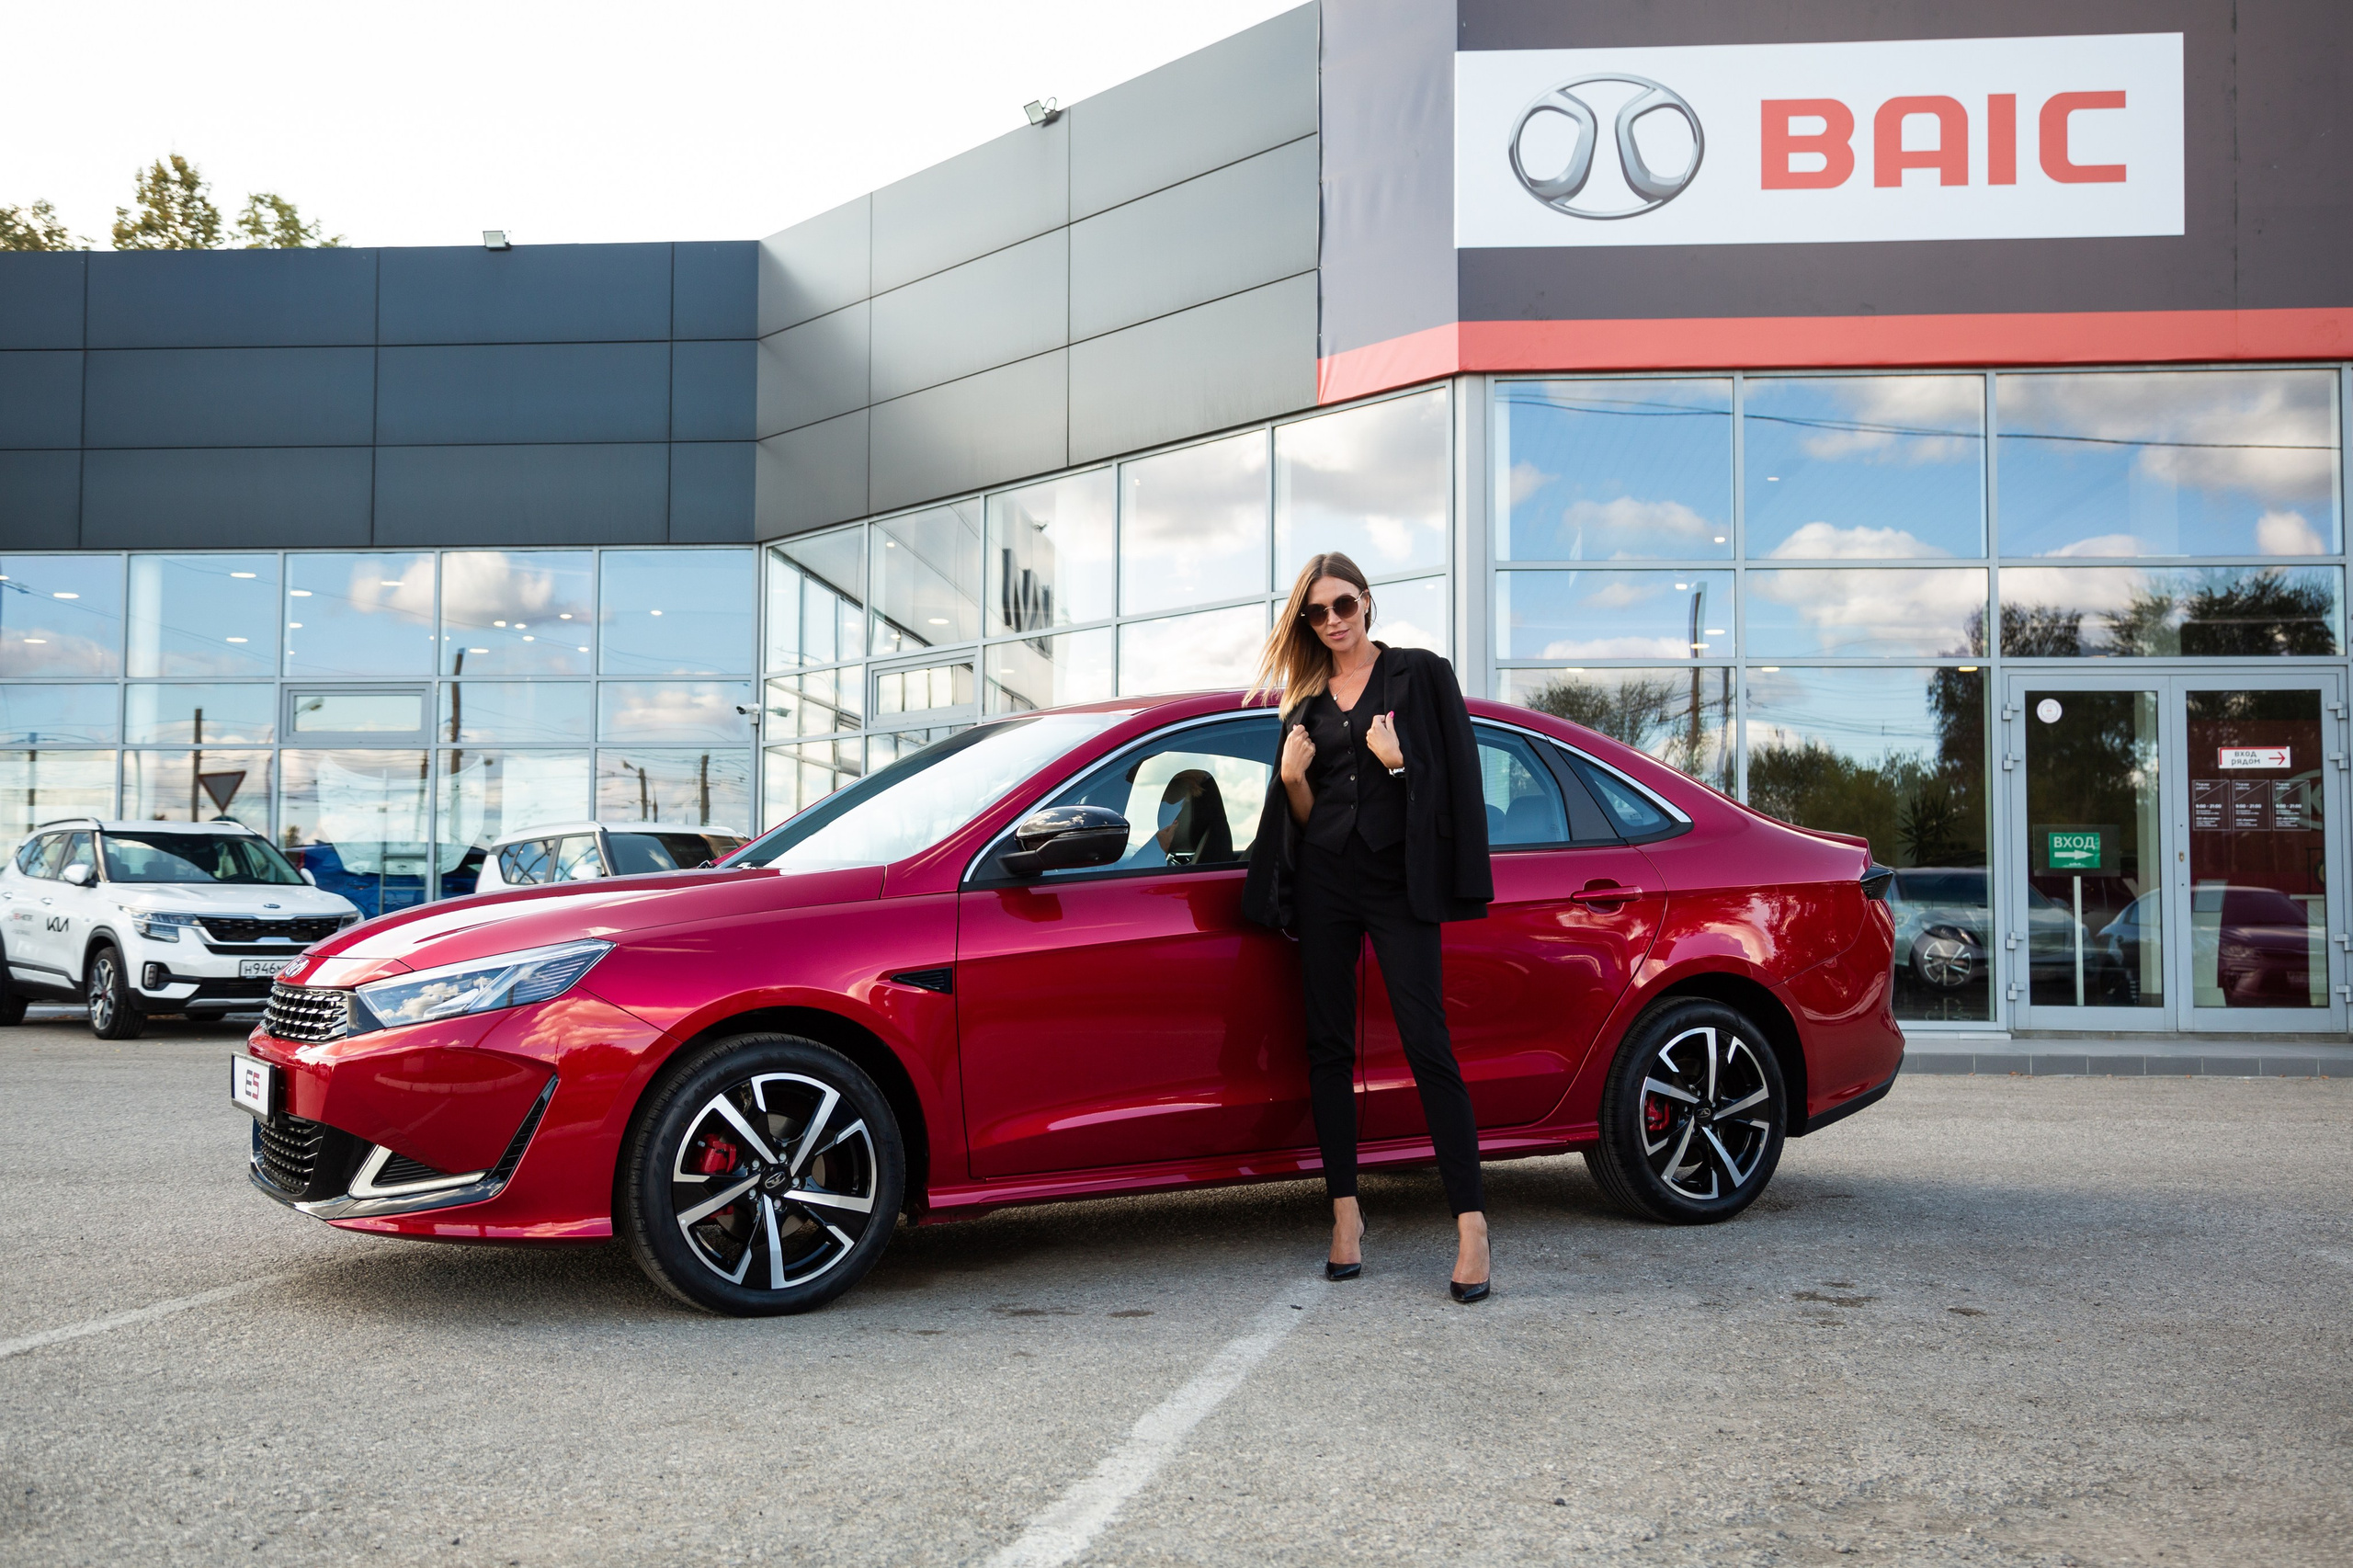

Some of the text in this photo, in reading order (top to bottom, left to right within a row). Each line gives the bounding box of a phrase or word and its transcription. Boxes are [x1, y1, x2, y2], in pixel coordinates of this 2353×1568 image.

[1761, 90, 2126, 189] BAIC
[2053, 836, 2096, 850] ВХОД
[47, 916, 70, 932] KIA
